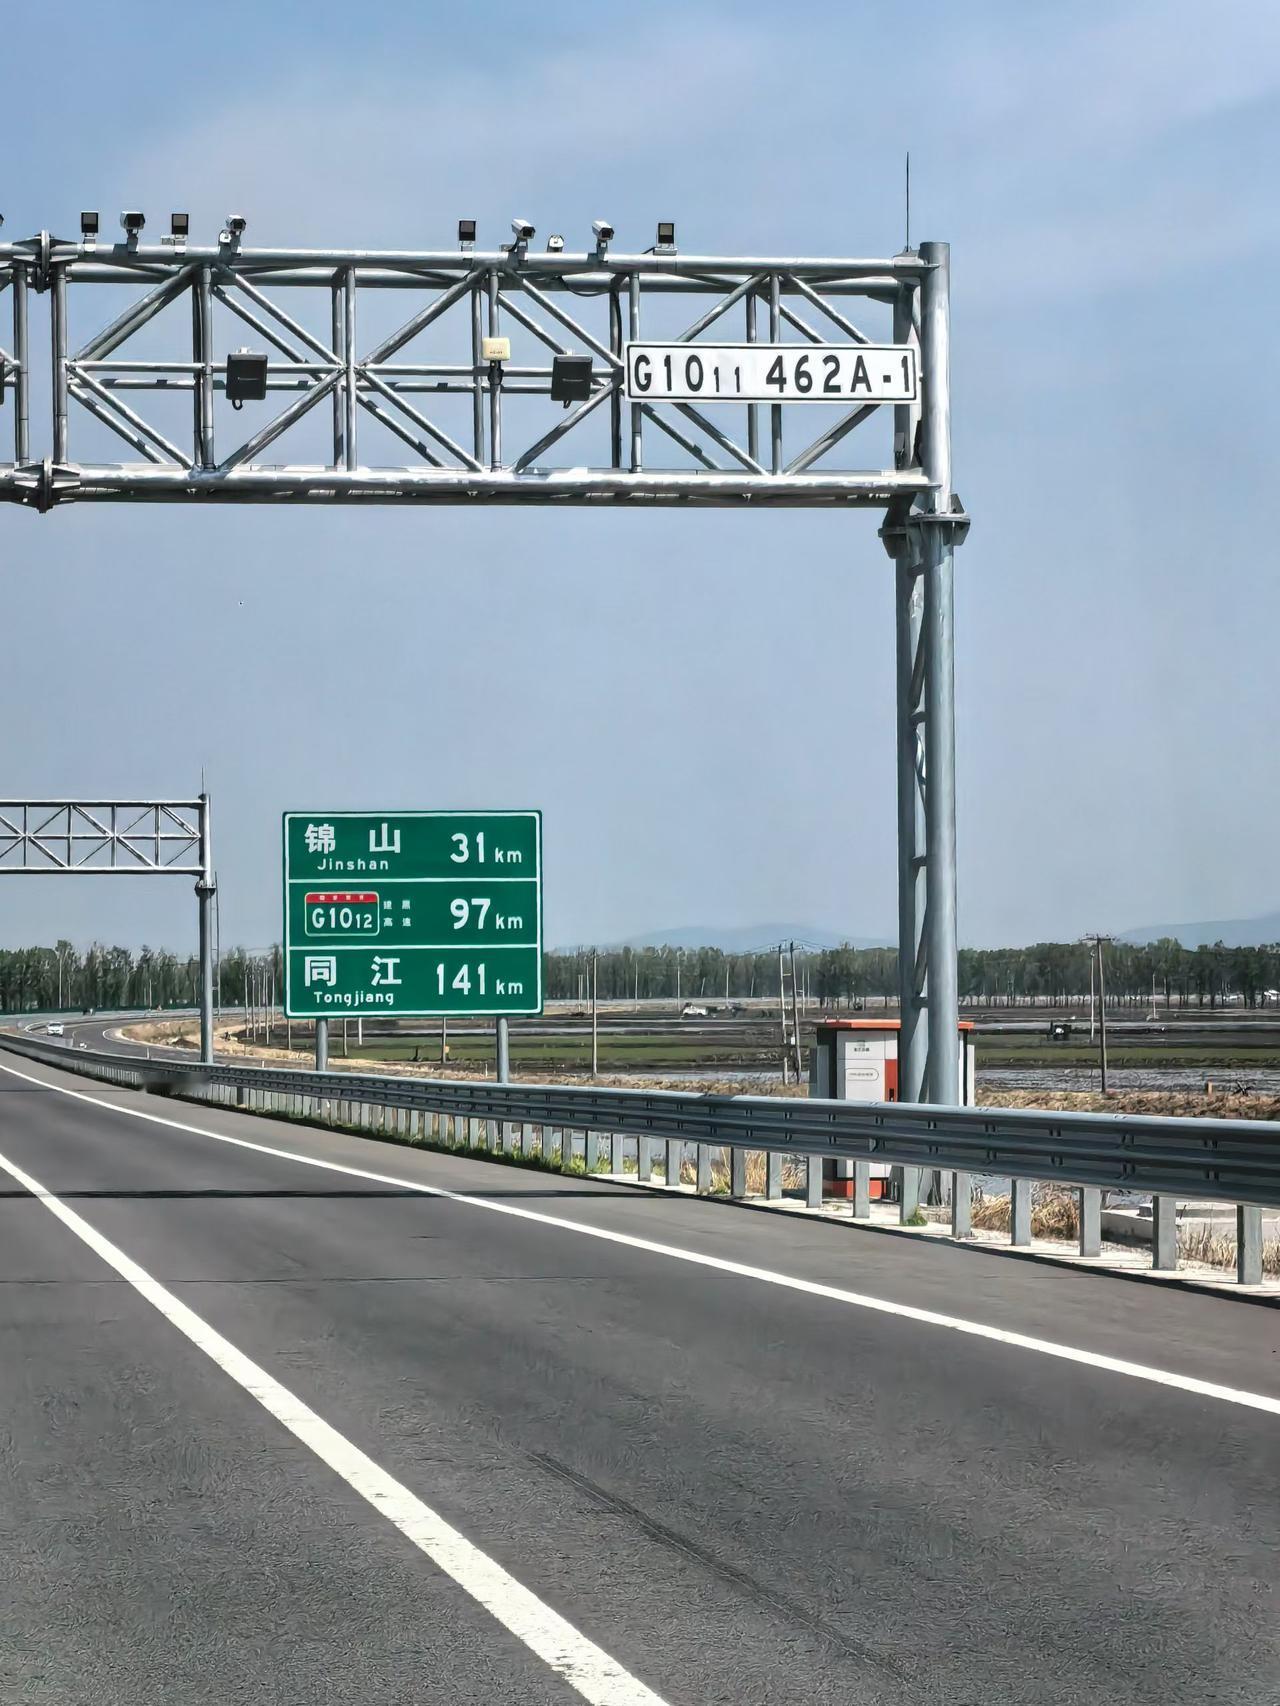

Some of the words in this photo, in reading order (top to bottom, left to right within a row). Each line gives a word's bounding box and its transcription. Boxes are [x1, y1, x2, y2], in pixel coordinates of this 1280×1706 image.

[634, 354, 741, 393] G1011
[765, 354, 911, 394] 462A-1
[304, 822, 401, 854] 锦山
[450, 831, 485, 863] 31
[494, 847, 522, 863] km
[317, 858, 389, 871] Jinshan
[311, 907, 372, 929] G1012
[450, 898, 491, 930] 97
[495, 913, 523, 930] km
[304, 955, 402, 987] 同江
[436, 963, 486, 995] 141
[496, 979, 523, 995] km
[313, 991, 394, 1007] Tongjiang
